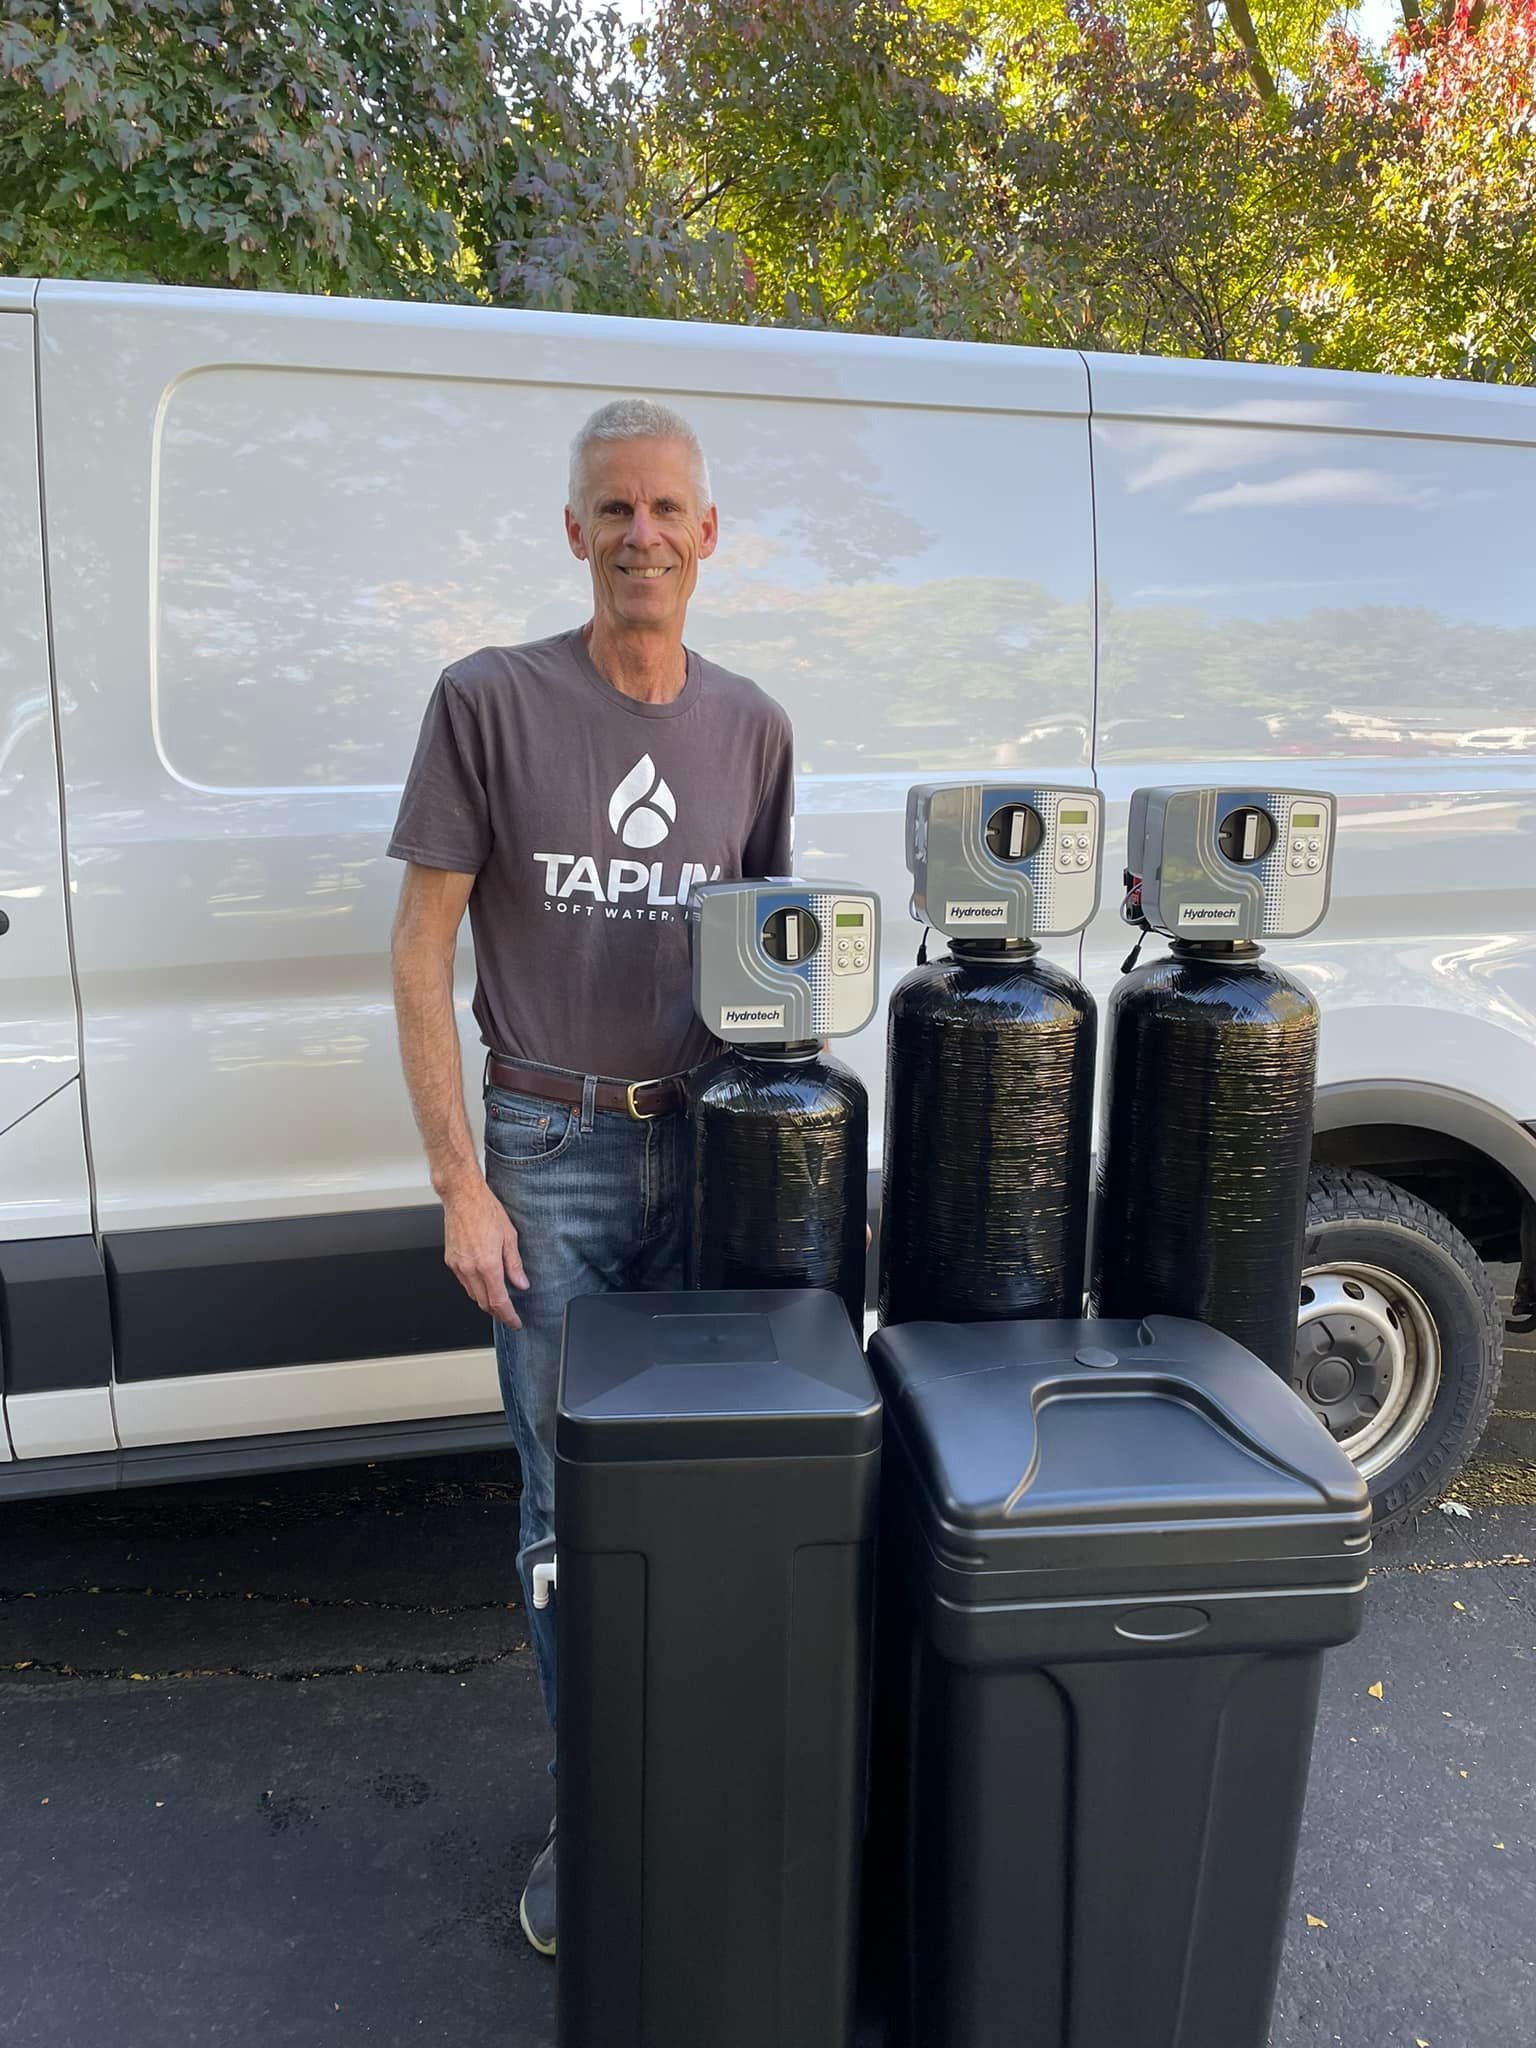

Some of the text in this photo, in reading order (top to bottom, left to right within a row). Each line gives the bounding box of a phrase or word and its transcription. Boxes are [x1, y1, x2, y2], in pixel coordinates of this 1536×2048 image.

[544, 901, 594, 917] SOFT
[605, 908, 675, 923] WATER,
[951, 906, 1003, 918] Hydrotech
[1184, 908, 1236, 920] Hydrotech
[726, 1010, 780, 1023] Hydrotech
[1384, 1361, 1481, 1512] WRANGLER
